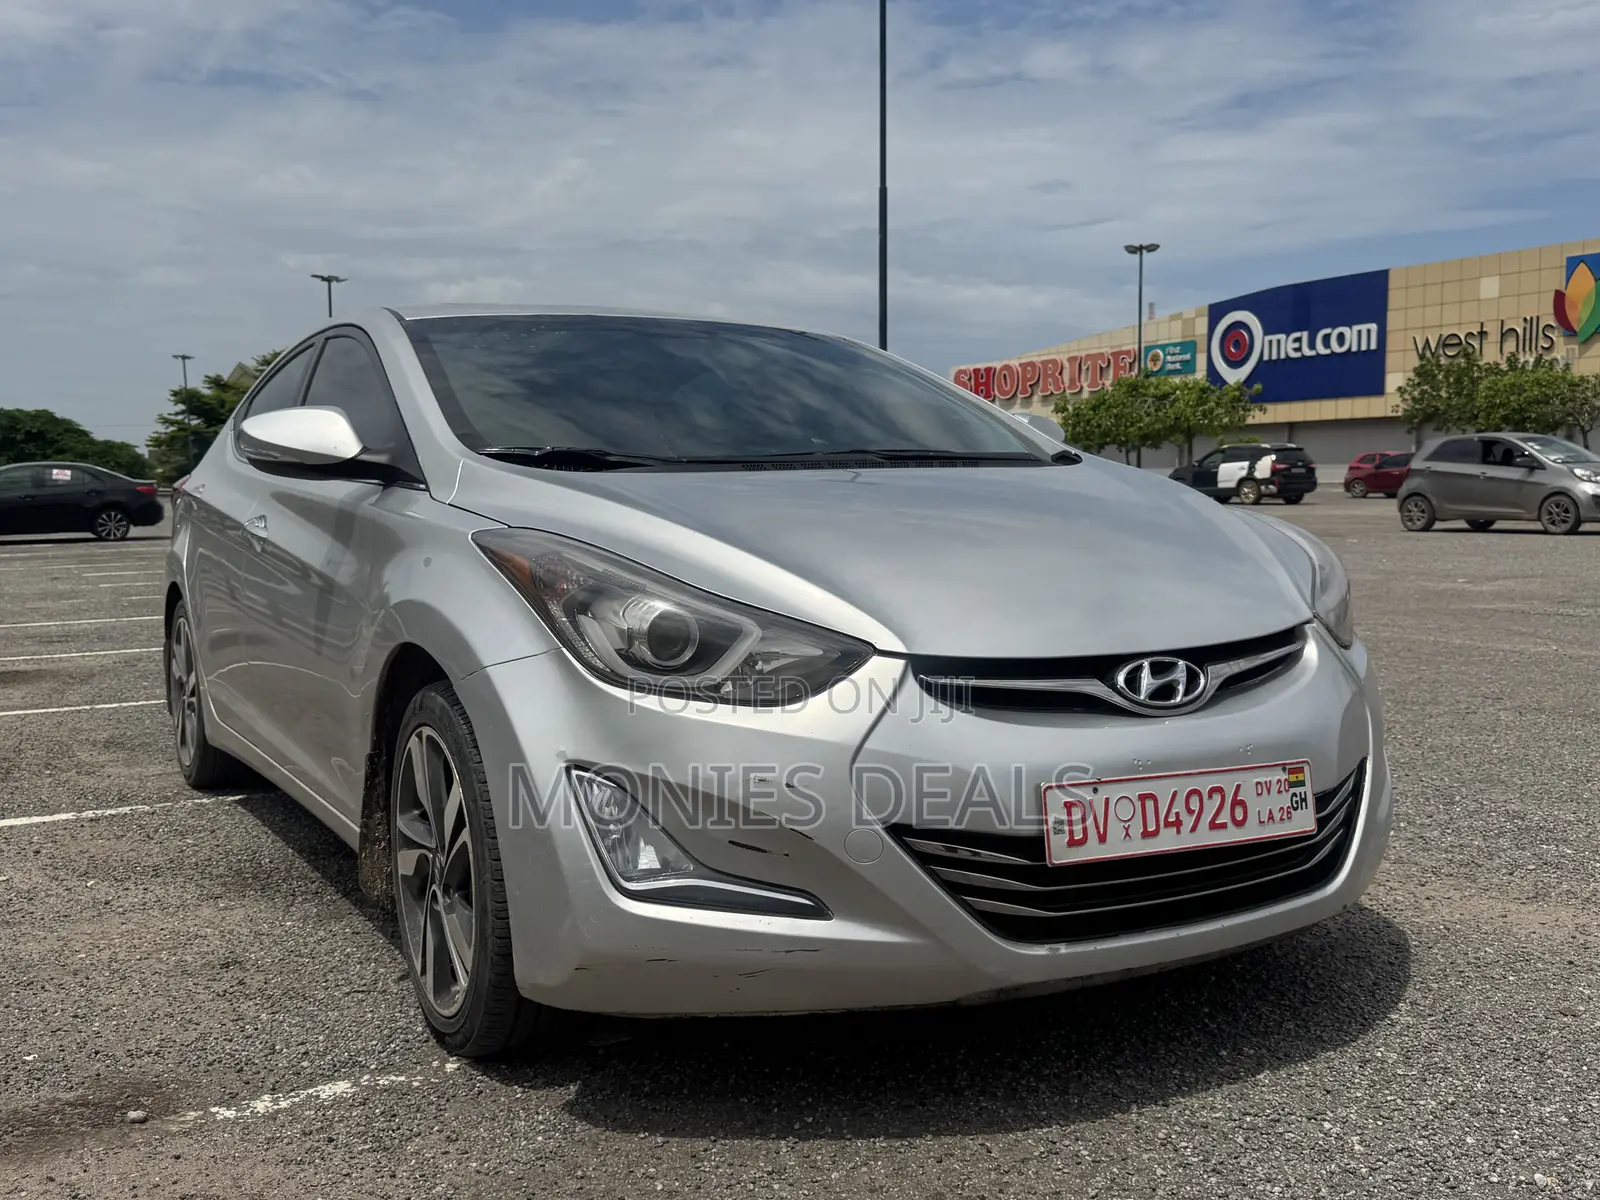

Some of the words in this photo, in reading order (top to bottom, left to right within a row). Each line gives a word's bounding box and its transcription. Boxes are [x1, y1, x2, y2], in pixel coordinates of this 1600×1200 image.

[1413, 322, 1488, 361] west
[1500, 316, 1557, 357] hills
[953, 347, 1138, 401] SHOPRITE
[1254, 779, 1272, 797] DV
[1290, 790, 1309, 812] GH
[1257, 807, 1276, 825] LA
